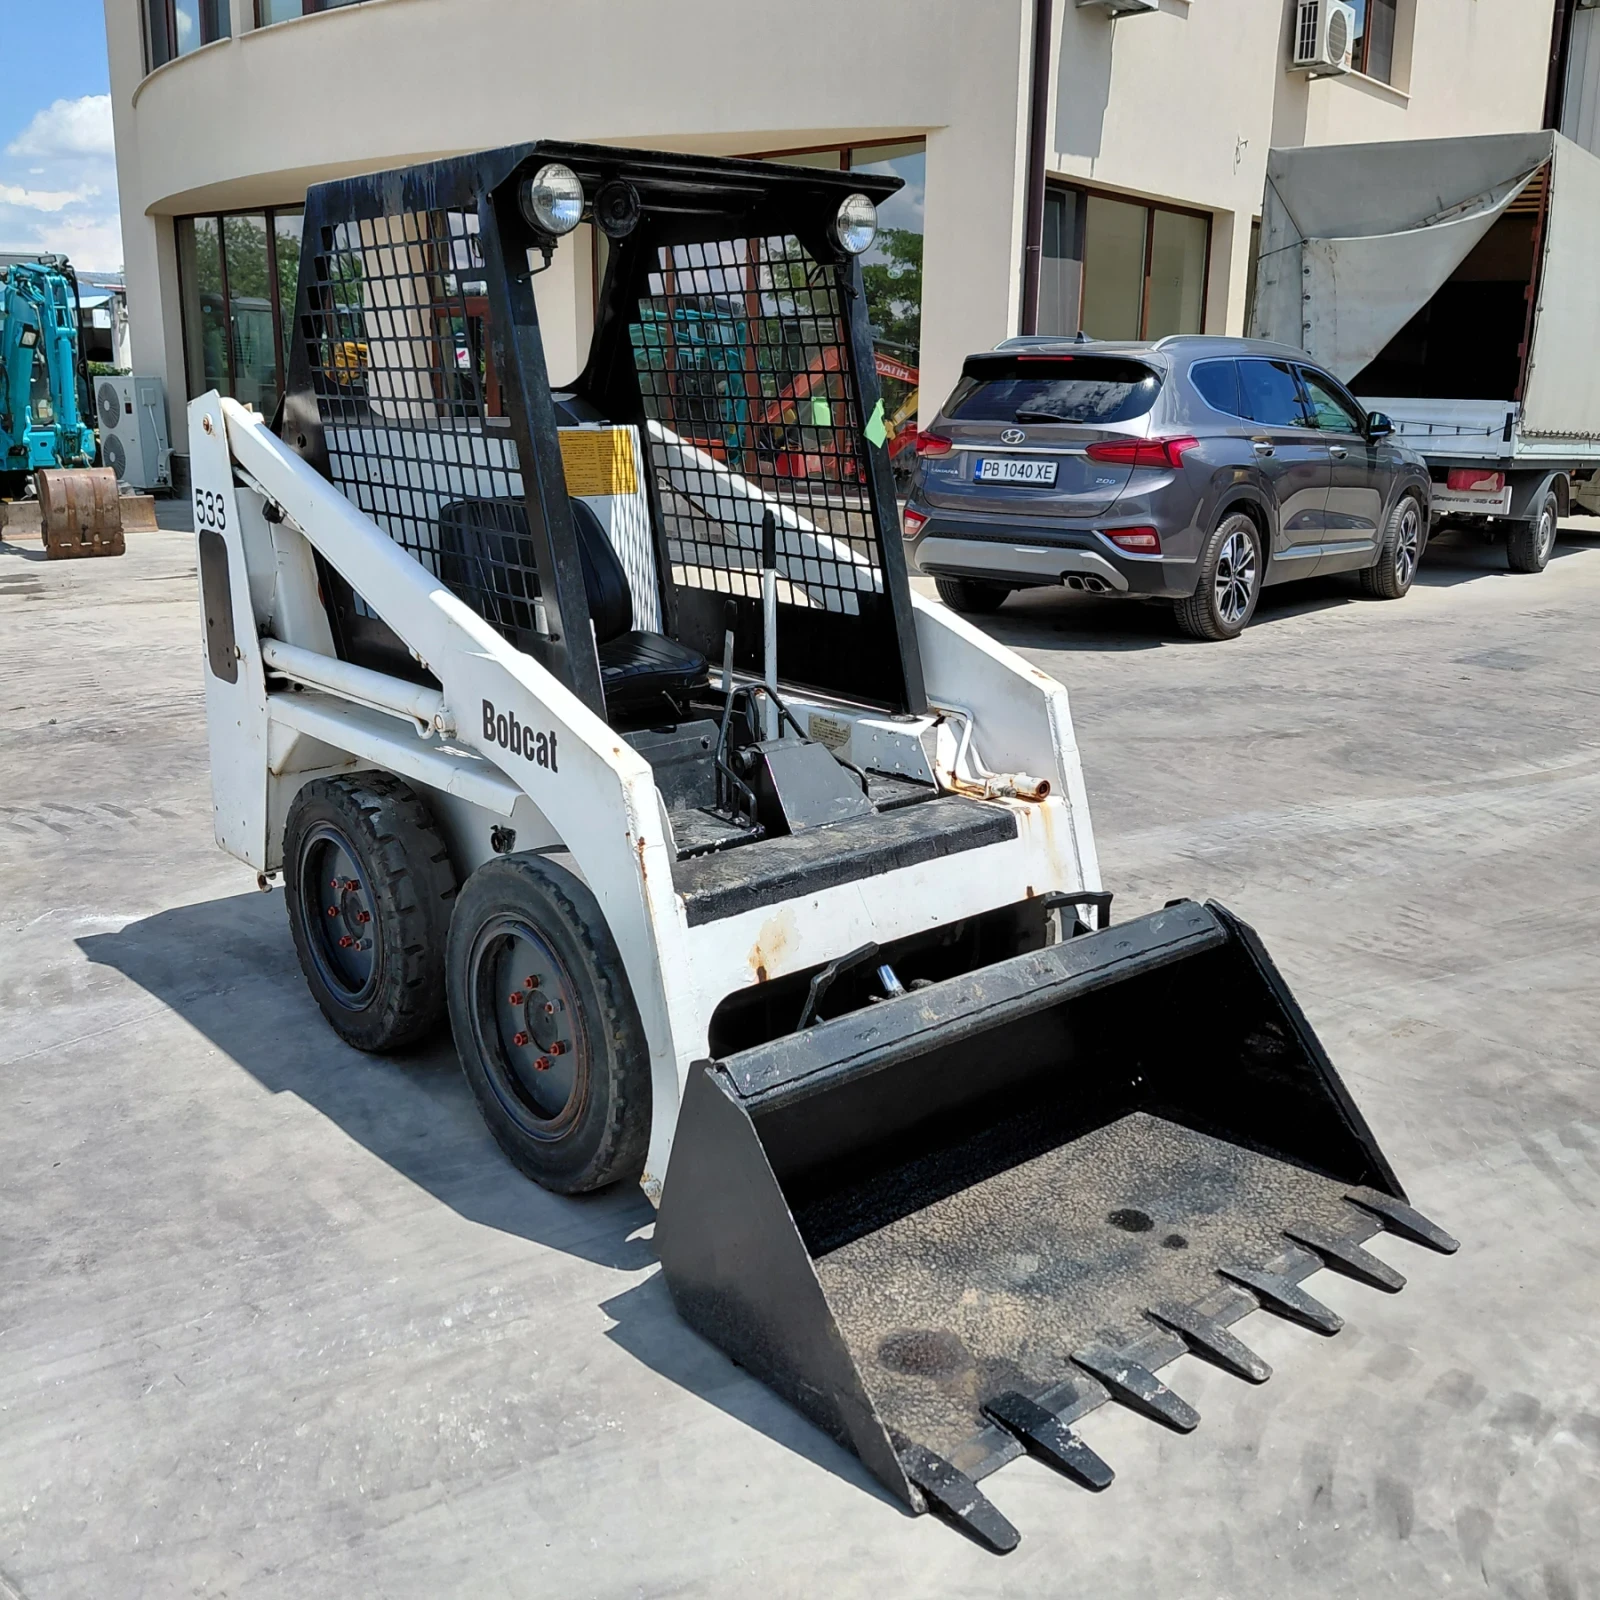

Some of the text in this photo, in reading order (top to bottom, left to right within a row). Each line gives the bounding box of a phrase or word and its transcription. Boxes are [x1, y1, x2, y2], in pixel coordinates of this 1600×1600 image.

[983, 462, 1053, 479] PB 1040 XE
[195, 488, 226, 530] 533
[482, 698, 558, 774] Bobcat
